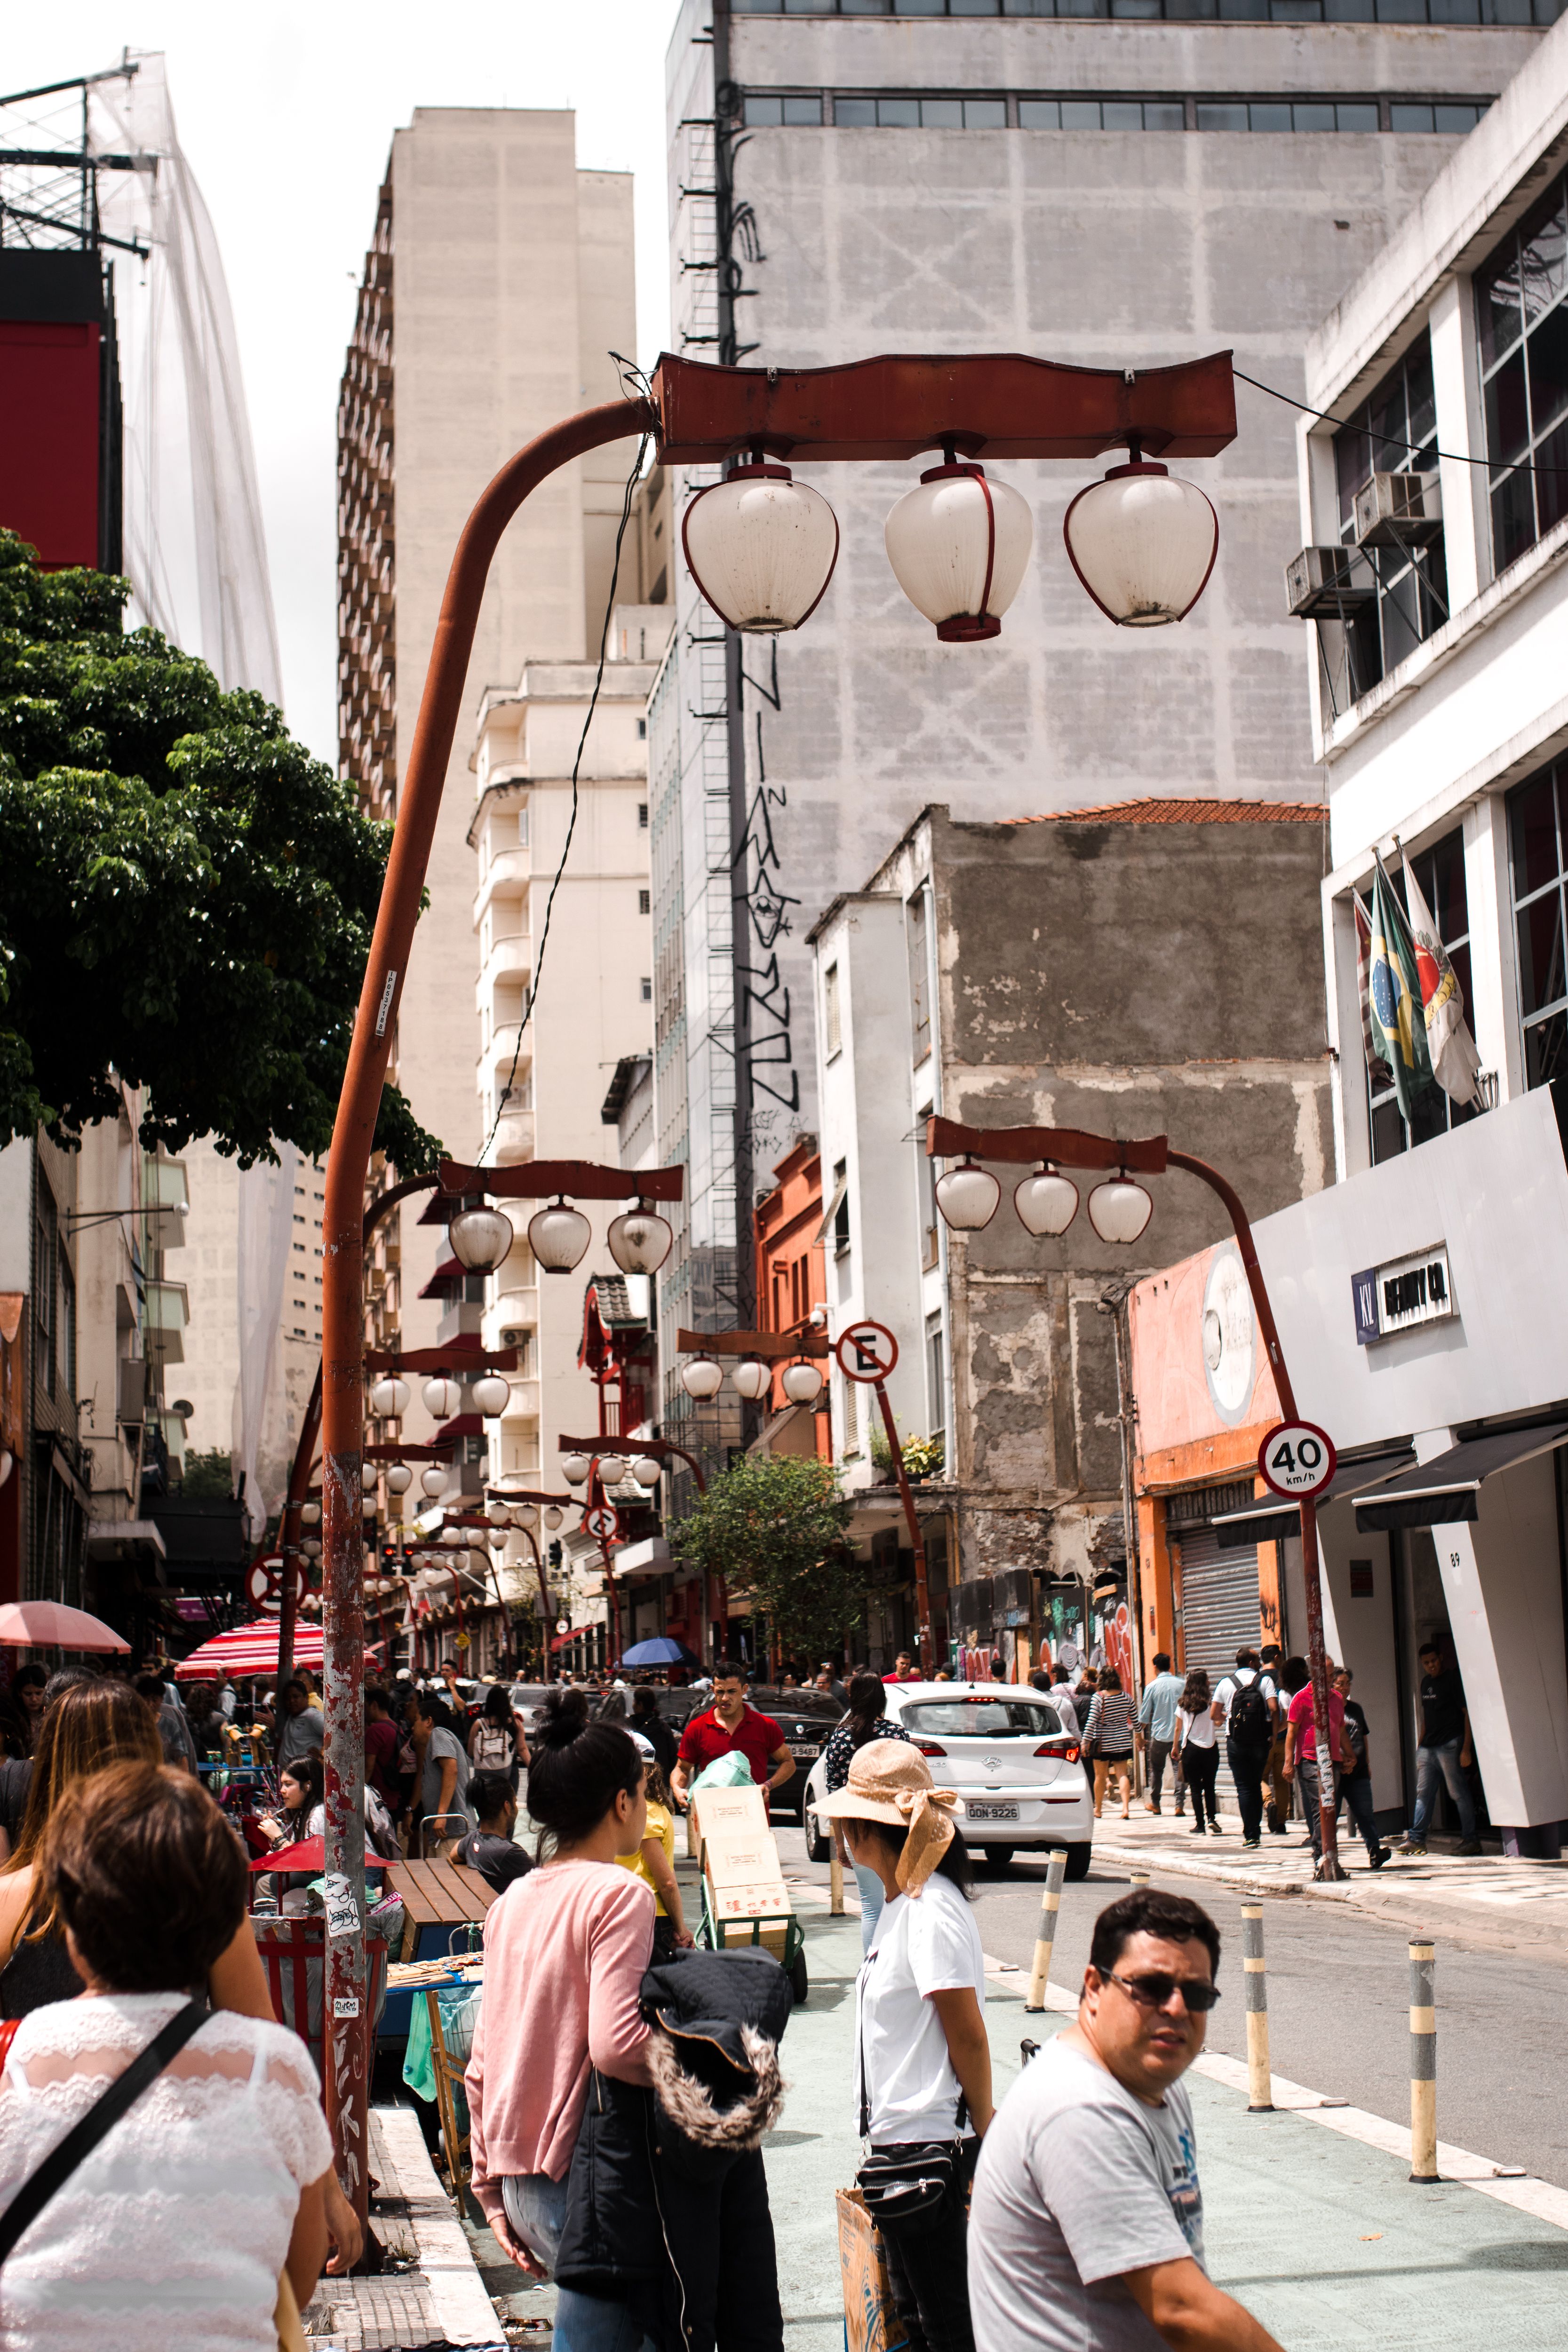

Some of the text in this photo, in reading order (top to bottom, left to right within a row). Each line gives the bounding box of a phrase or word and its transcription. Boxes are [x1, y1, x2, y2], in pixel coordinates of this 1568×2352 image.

[378, 971, 393, 1030] IP0537188
[1272, 1438, 1321, 1473] 40
[1286, 1472, 1315, 1486] km/h
[1450, 1552, 1460, 1568] 89
